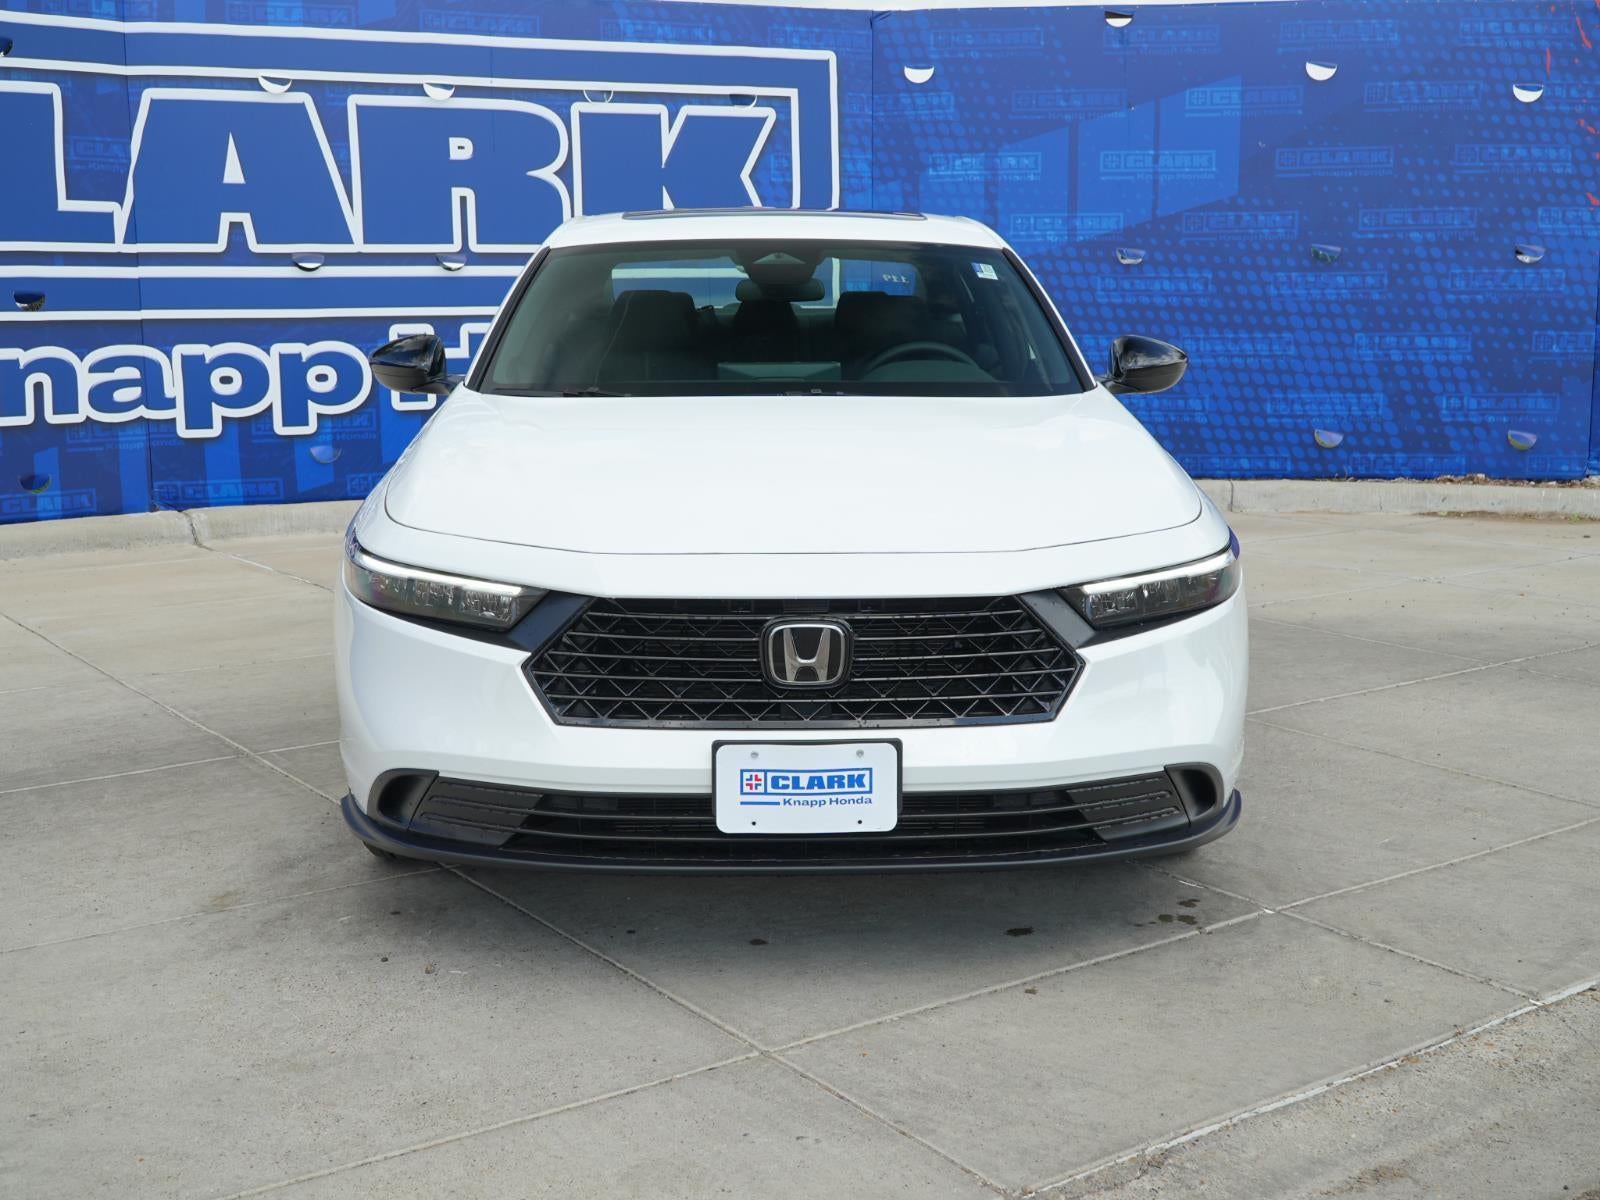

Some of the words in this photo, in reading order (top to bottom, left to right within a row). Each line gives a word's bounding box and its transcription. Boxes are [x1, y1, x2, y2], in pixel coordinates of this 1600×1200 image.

[1125, 154, 1212, 170] CLARK
[770, 773, 866, 790] CLARK
[783, 798, 827, 808] Knapp
[829, 796, 873, 806] Honda
